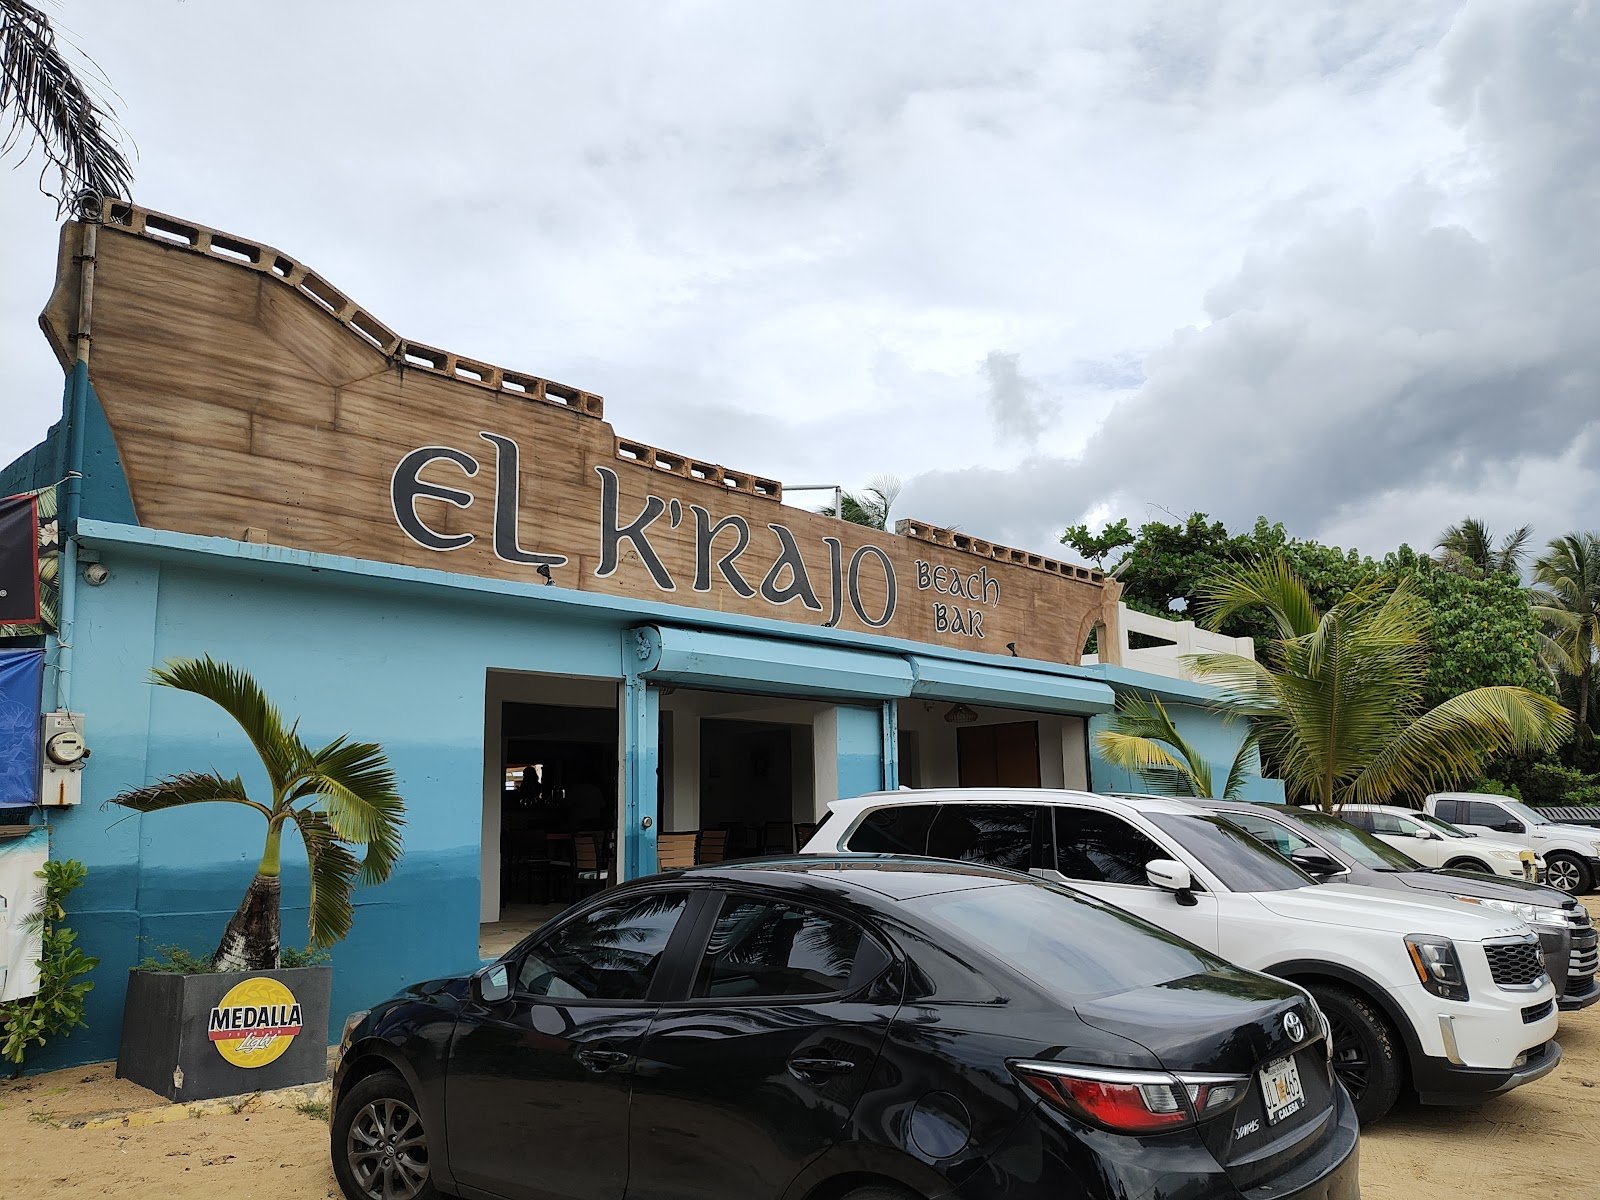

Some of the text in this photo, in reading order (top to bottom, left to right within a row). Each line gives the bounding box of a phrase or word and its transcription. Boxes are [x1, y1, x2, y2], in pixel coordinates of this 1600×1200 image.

[391, 431, 568, 568] EL
[934, 601, 985, 639] BAR
[209, 1004, 303, 1031] MEDALLA
[235, 1032, 278, 1054] Light
[1278, 1101, 1300, 1120] CALESA
[1235, 1118, 1260, 1140] YARIS
